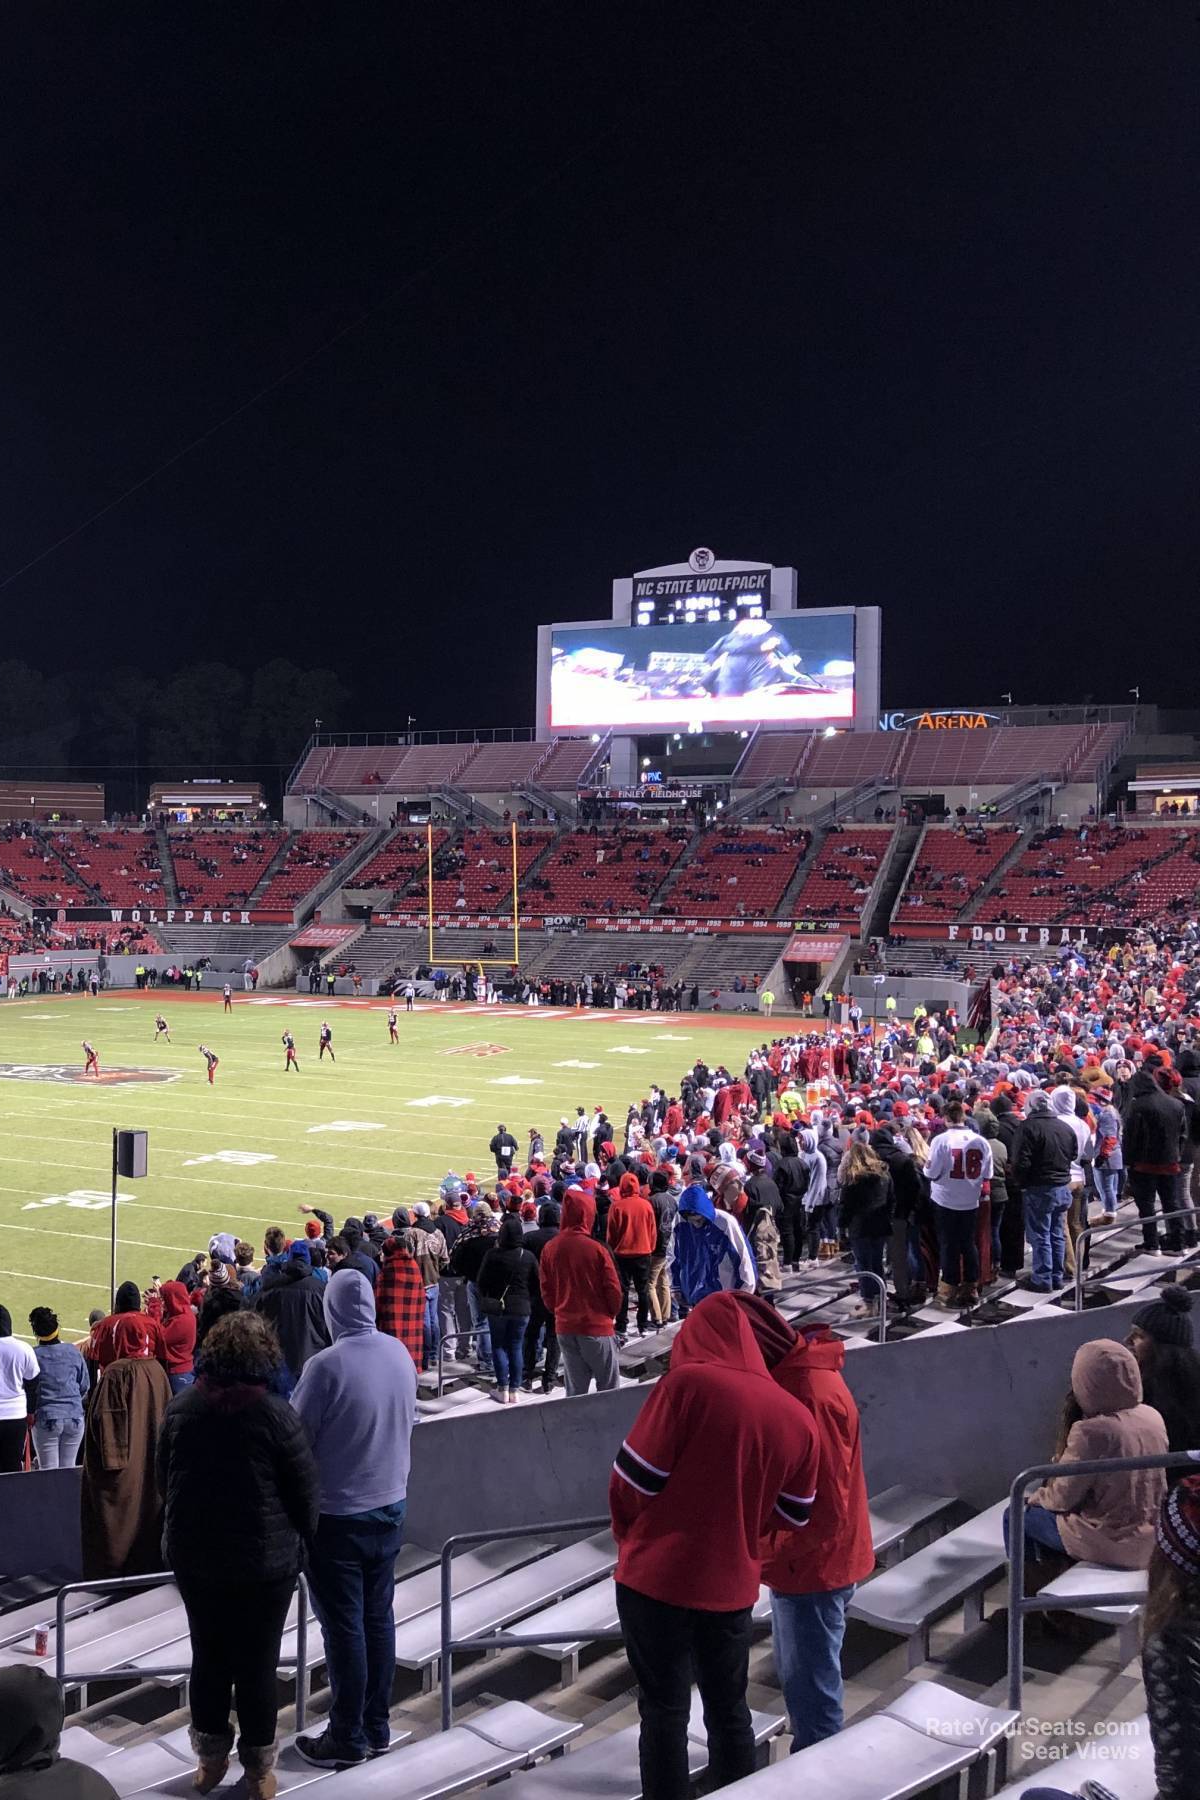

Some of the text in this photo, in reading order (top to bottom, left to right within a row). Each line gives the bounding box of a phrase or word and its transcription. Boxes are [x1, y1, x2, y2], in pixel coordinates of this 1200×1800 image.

[636, 574, 767, 596] NC STATE WOLFPACK
[879, 713, 907, 731] NC
[647, 772, 662, 781] PNC
[618, 790, 647, 798] FINLEY
[650, 789, 703, 798] FIELDHOUSE
[111, 910, 250, 924] WOLFPACK
[949, 925, 1089, 944] FOOTBAL
